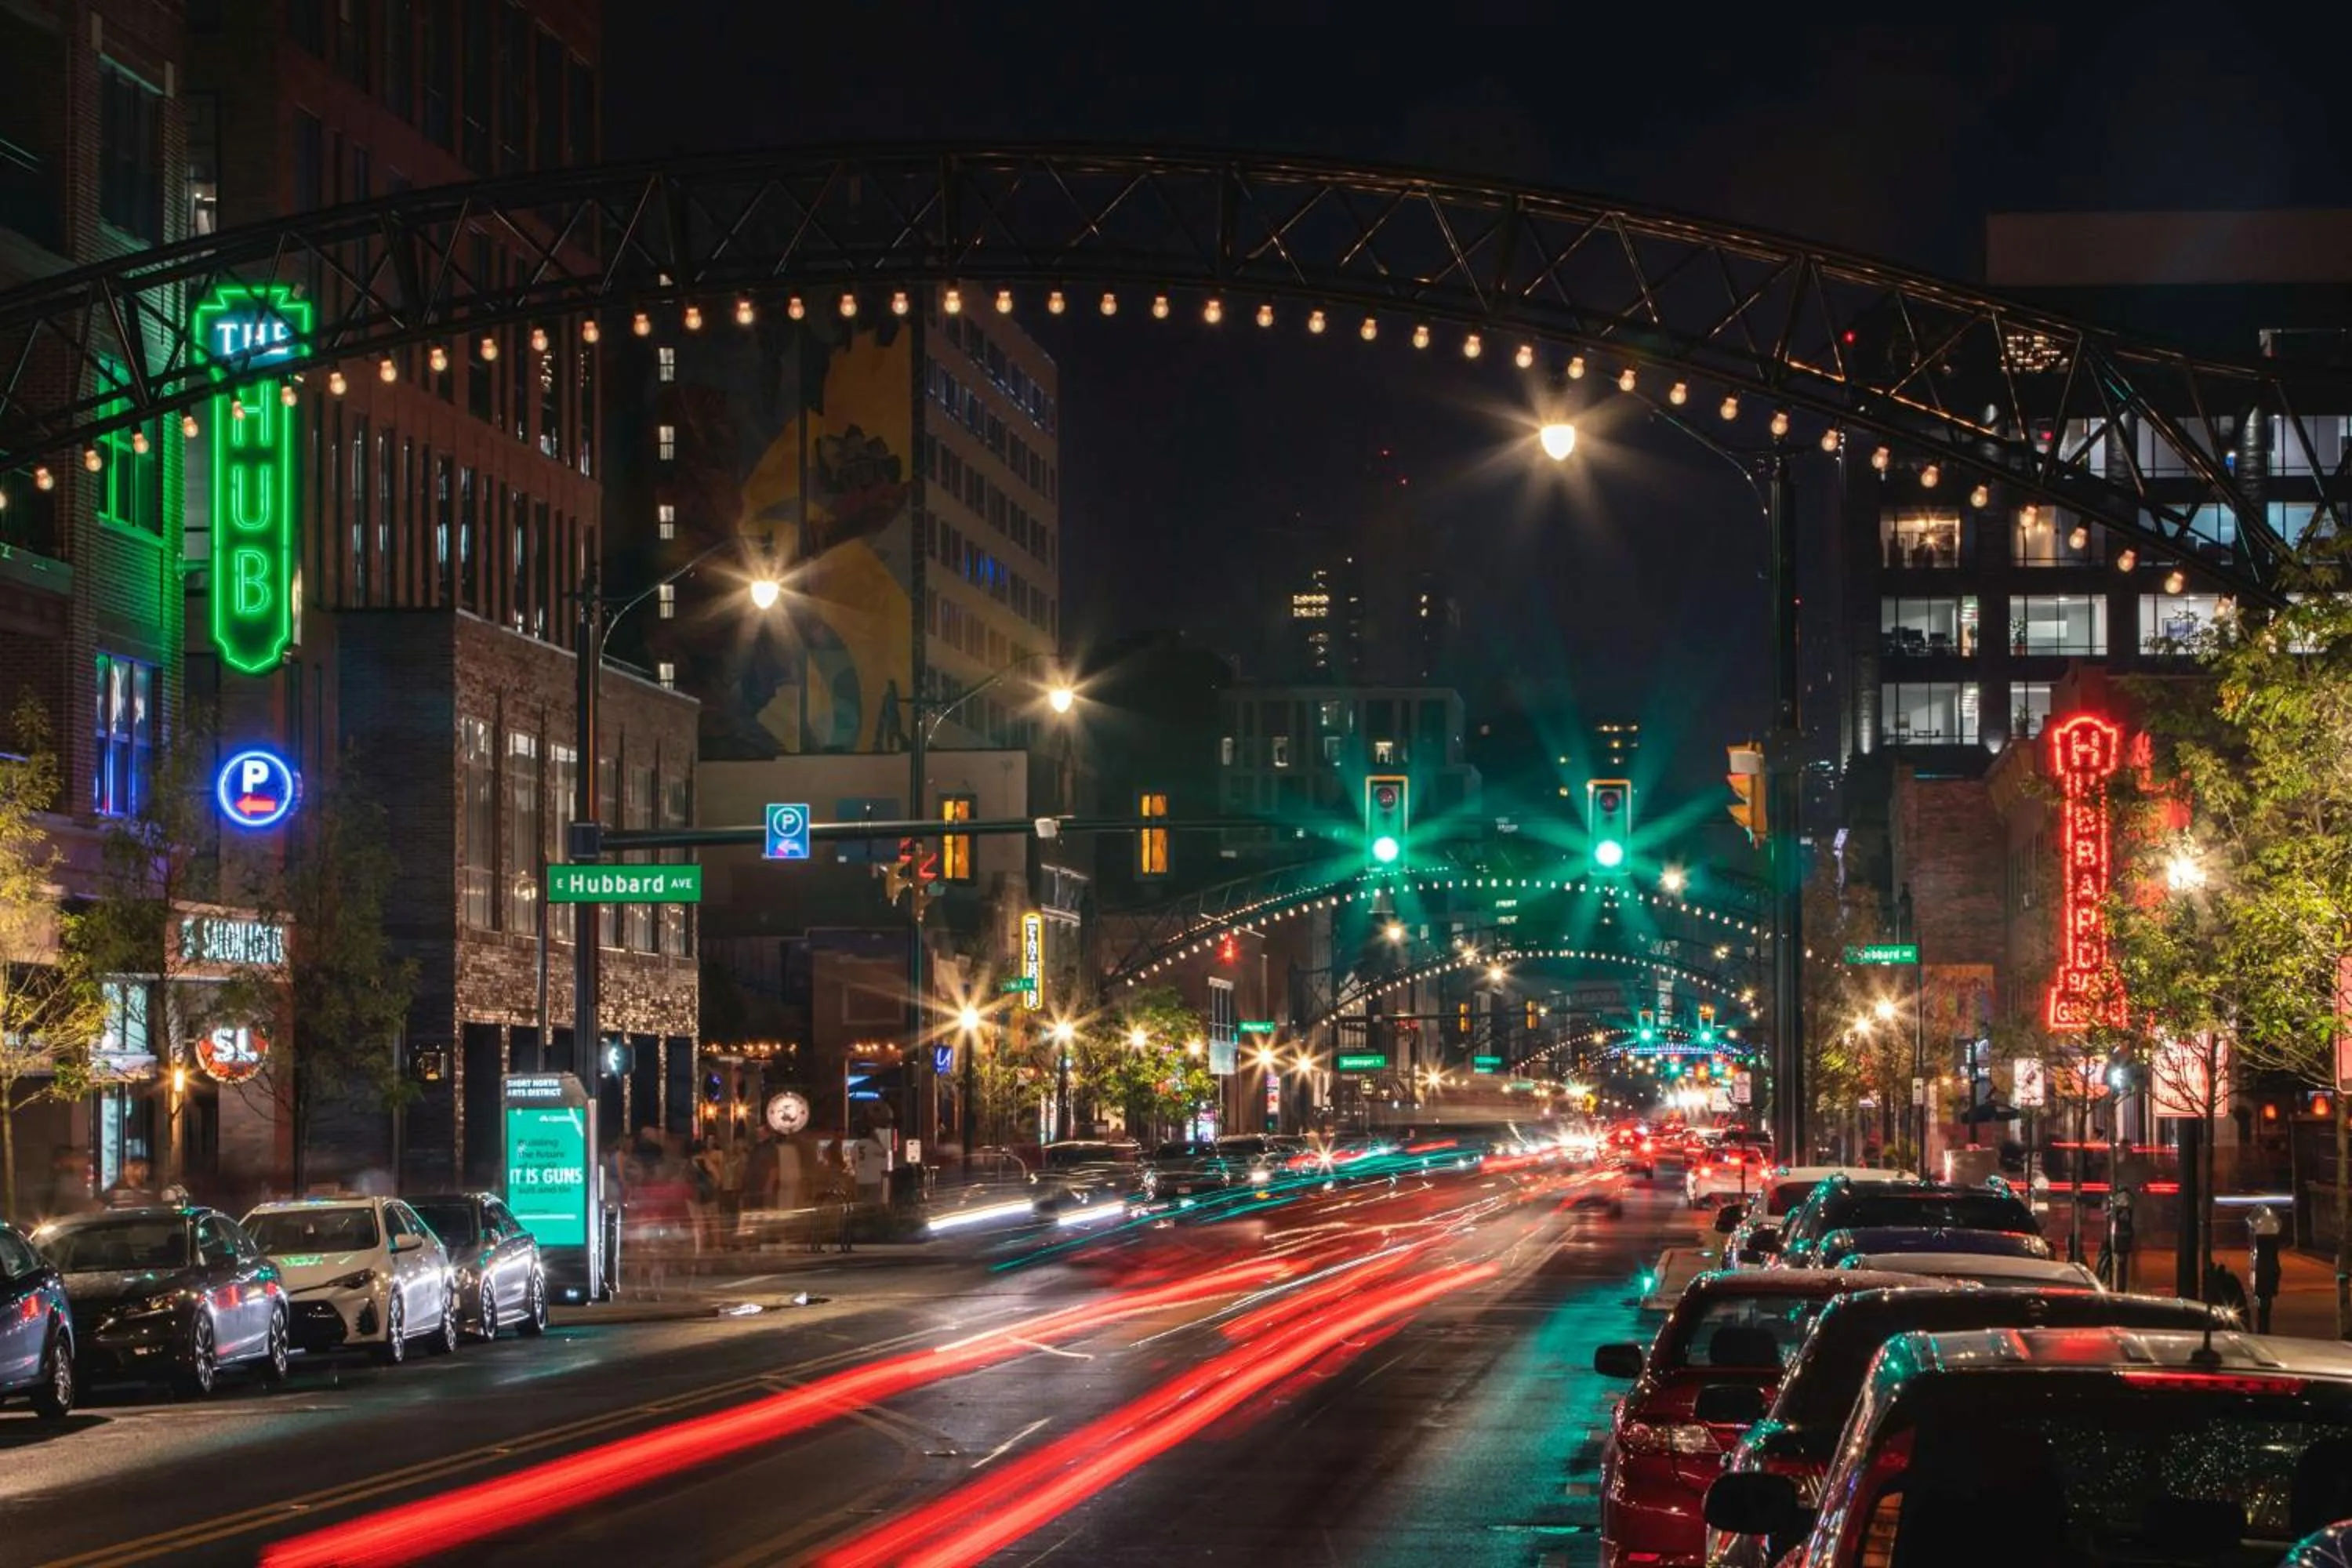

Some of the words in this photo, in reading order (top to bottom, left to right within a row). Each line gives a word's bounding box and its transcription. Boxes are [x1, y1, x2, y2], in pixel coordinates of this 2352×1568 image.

[233, 380, 271, 615] HUB
[242, 760, 269, 793] P
[782, 814, 795, 830] P
[556, 877, 563, 888] E
[570, 874, 664, 893] Hubbard
[671, 878, 693, 888] AVE
[212, 1028, 258, 1062] SL
[510, 1168, 522, 1184] IT
[526, 1168, 539, 1184] IS
[543, 1167, 583, 1184] GUNS
